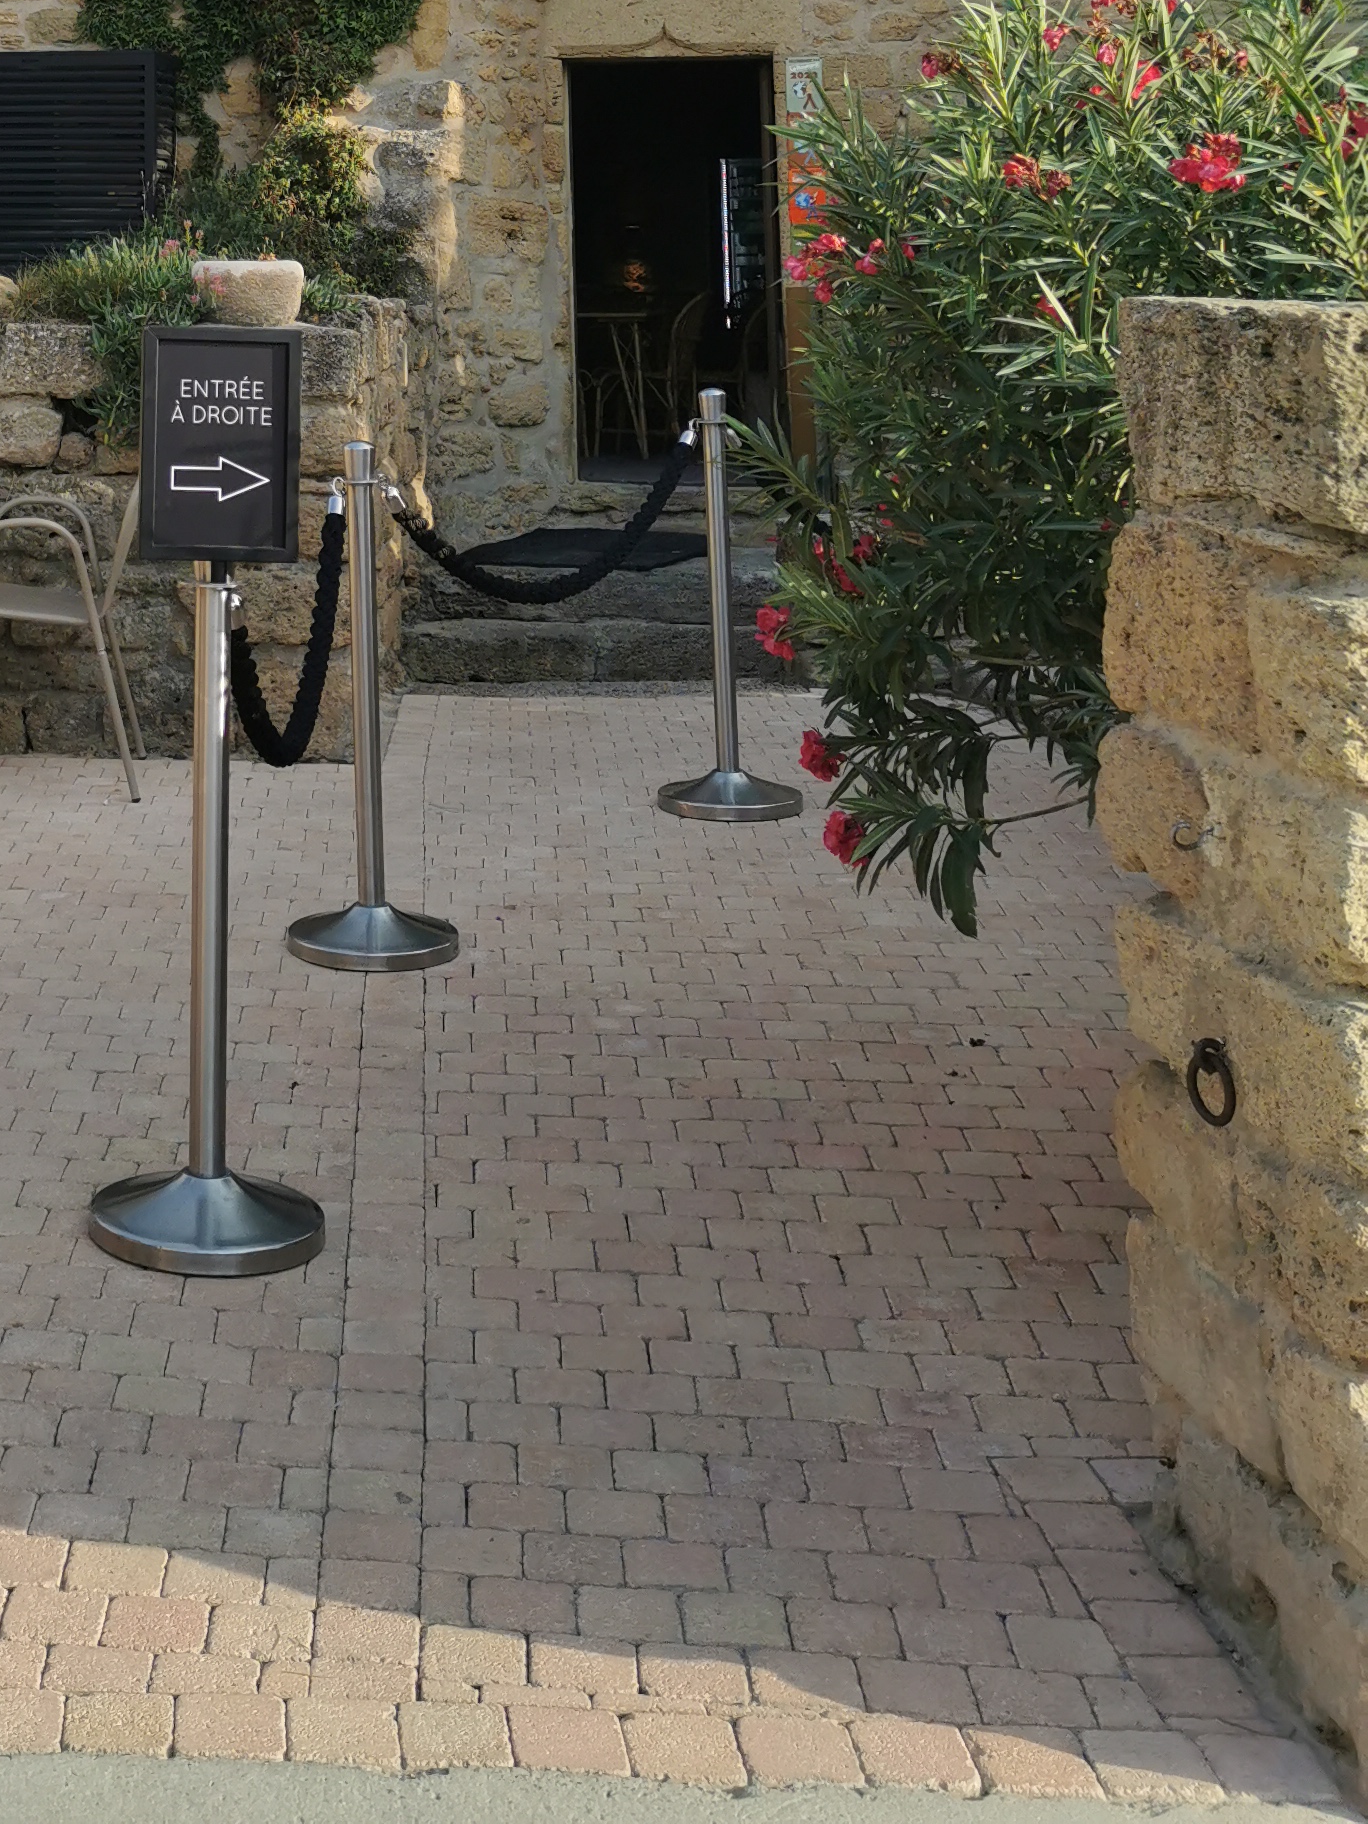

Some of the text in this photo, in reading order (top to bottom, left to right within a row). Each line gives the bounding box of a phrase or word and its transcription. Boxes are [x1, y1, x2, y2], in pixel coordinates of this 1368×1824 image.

[179, 375, 265, 400] ENTRÉE
[170, 400, 273, 426] À DROITE
